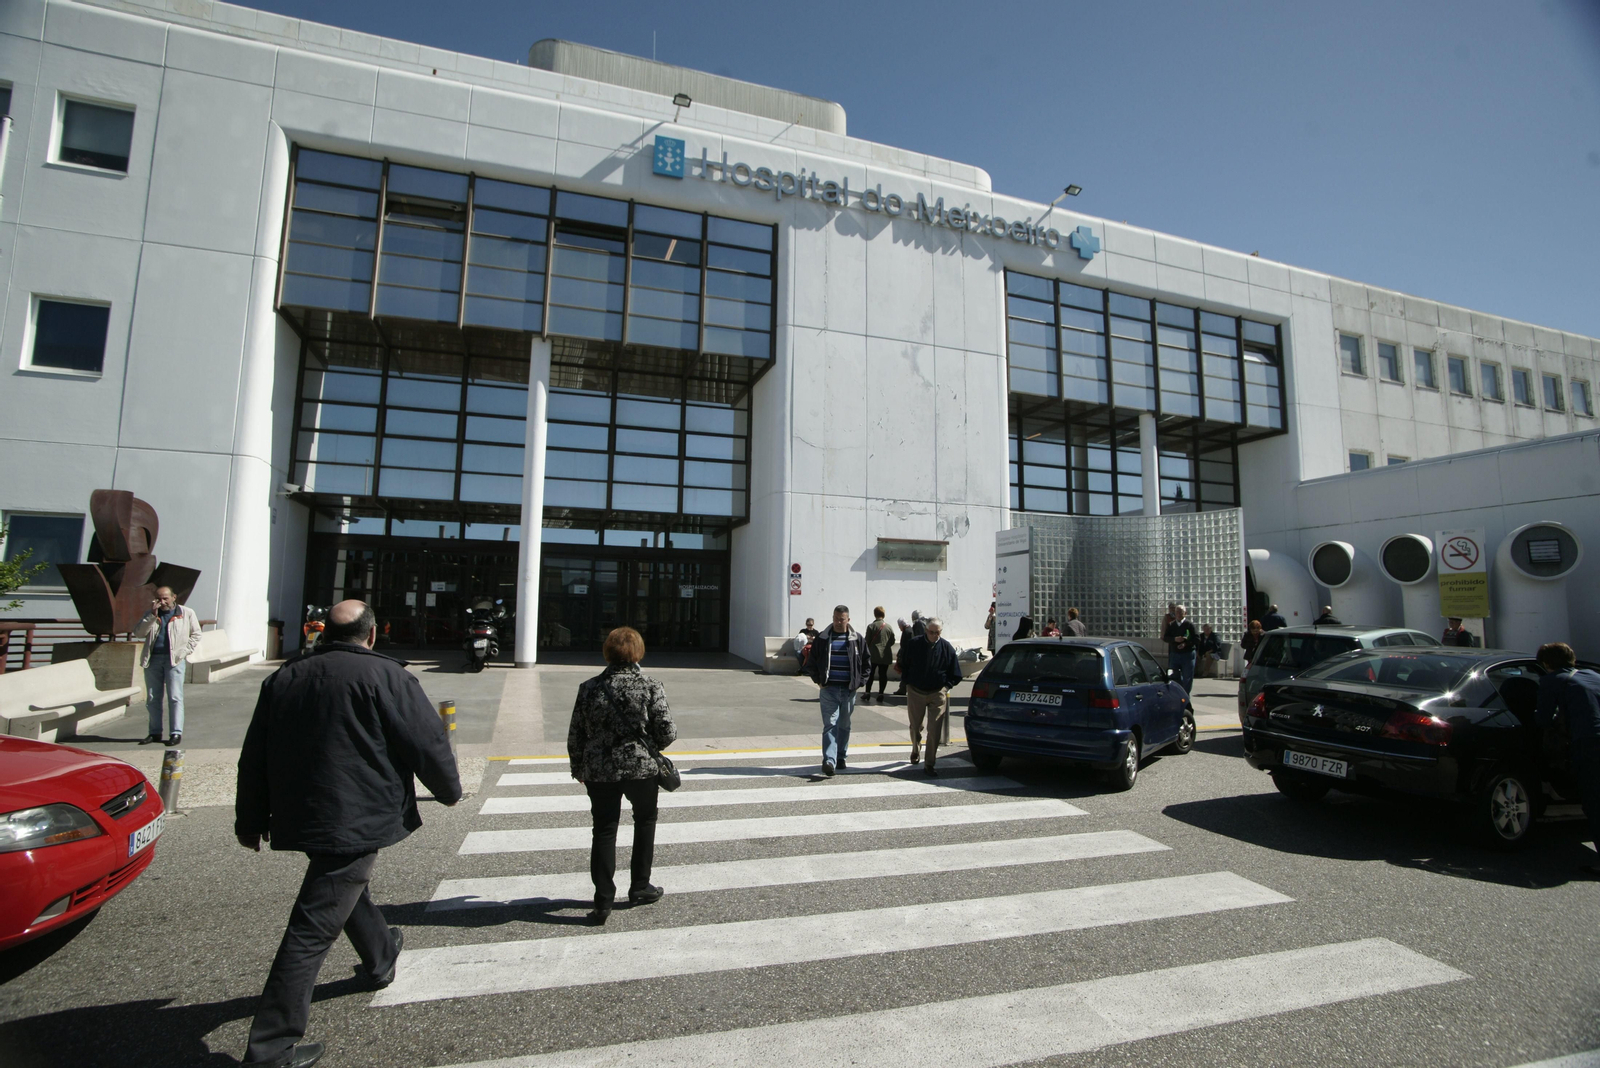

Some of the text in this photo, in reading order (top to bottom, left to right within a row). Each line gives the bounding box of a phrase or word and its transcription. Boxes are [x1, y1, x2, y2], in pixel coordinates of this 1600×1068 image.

[700, 147, 1061, 249] Hospital do Meixoeiro
[1440, 579, 1485, 587] prohibido
[1292, 753, 1343, 775] 9870 FZR
